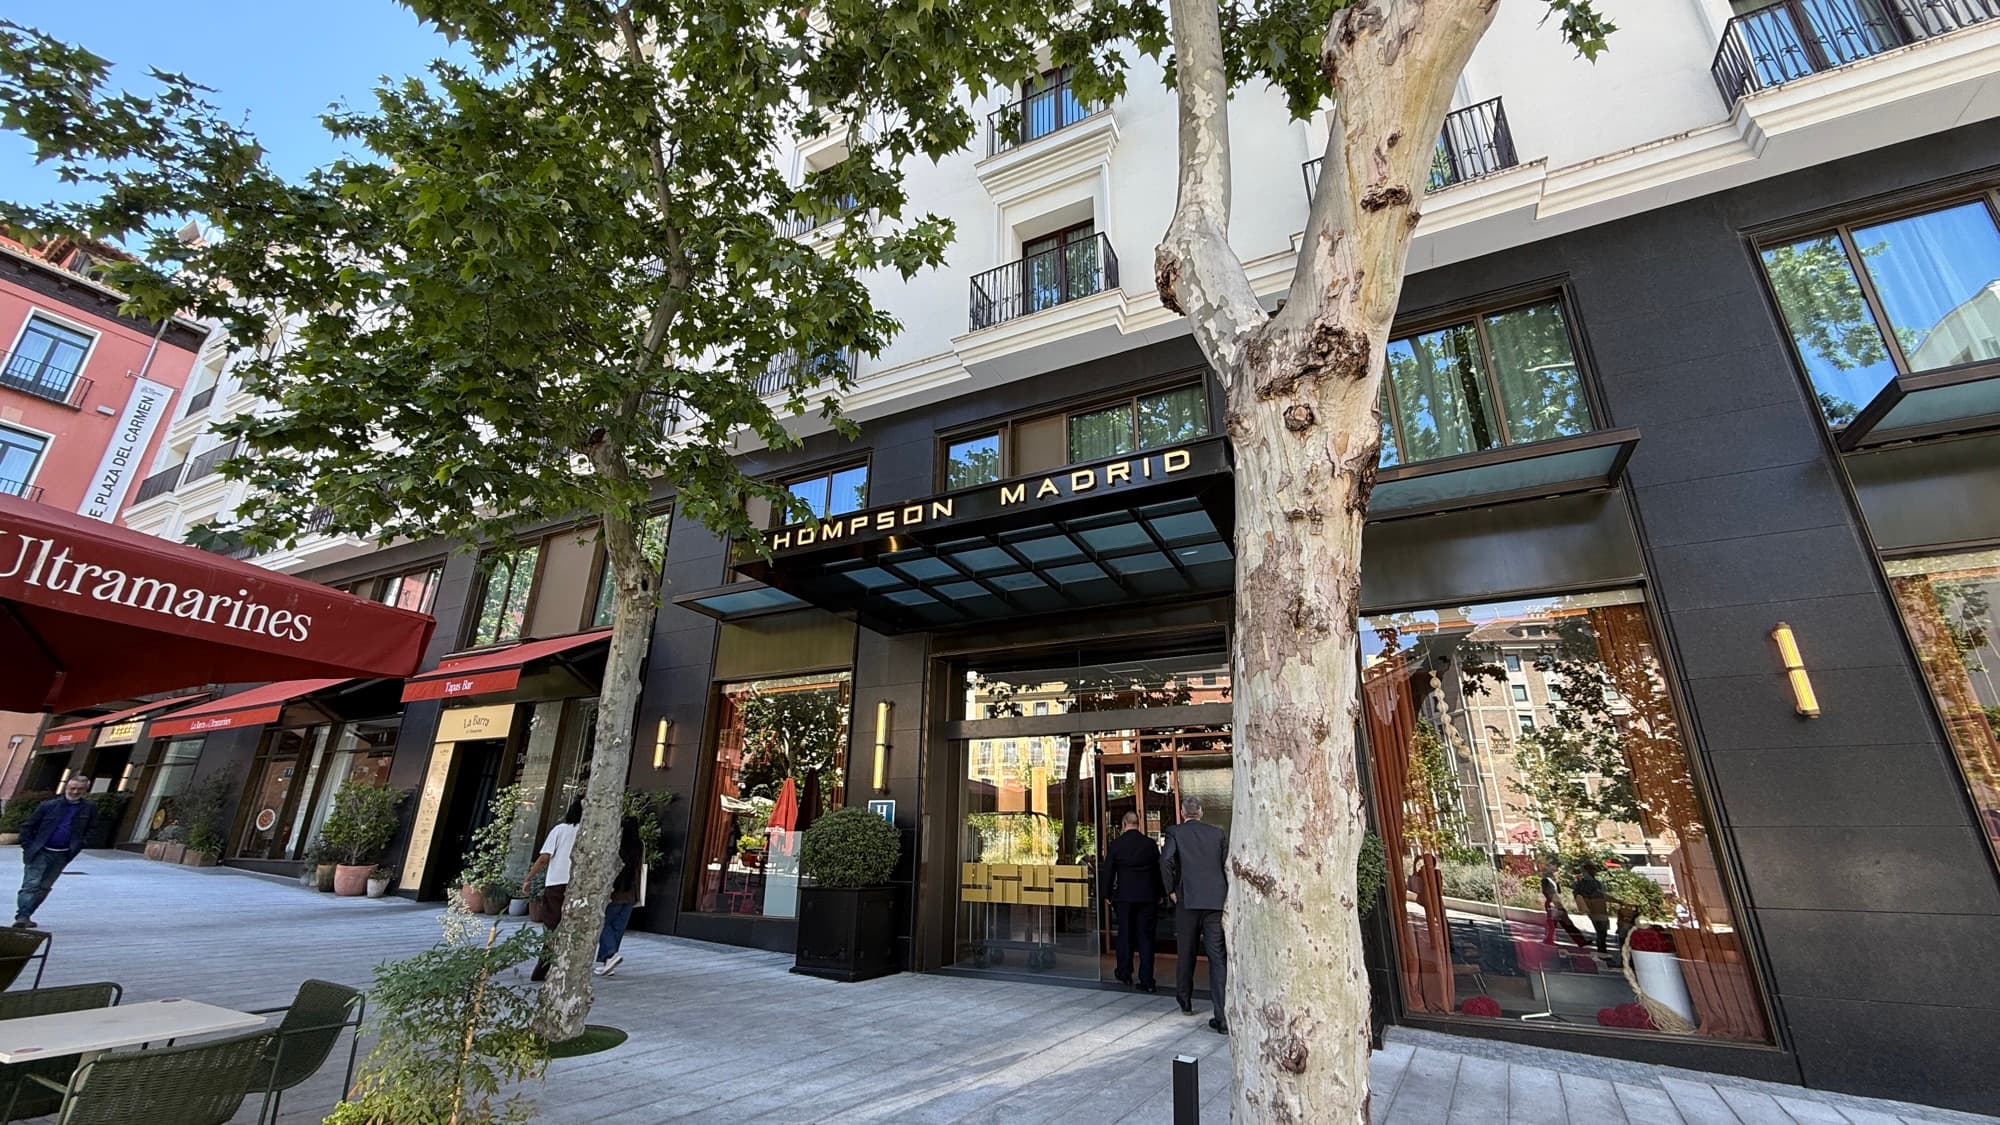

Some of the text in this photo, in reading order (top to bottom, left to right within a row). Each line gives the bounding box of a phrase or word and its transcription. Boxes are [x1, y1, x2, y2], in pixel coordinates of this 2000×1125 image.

[112, 445, 133, 467] DEL
[124, 395, 155, 443] CARMEN
[752, 449, 1190, 553] HOMPSON MADRID
[445, 680, 474, 695] Tapas Bar
